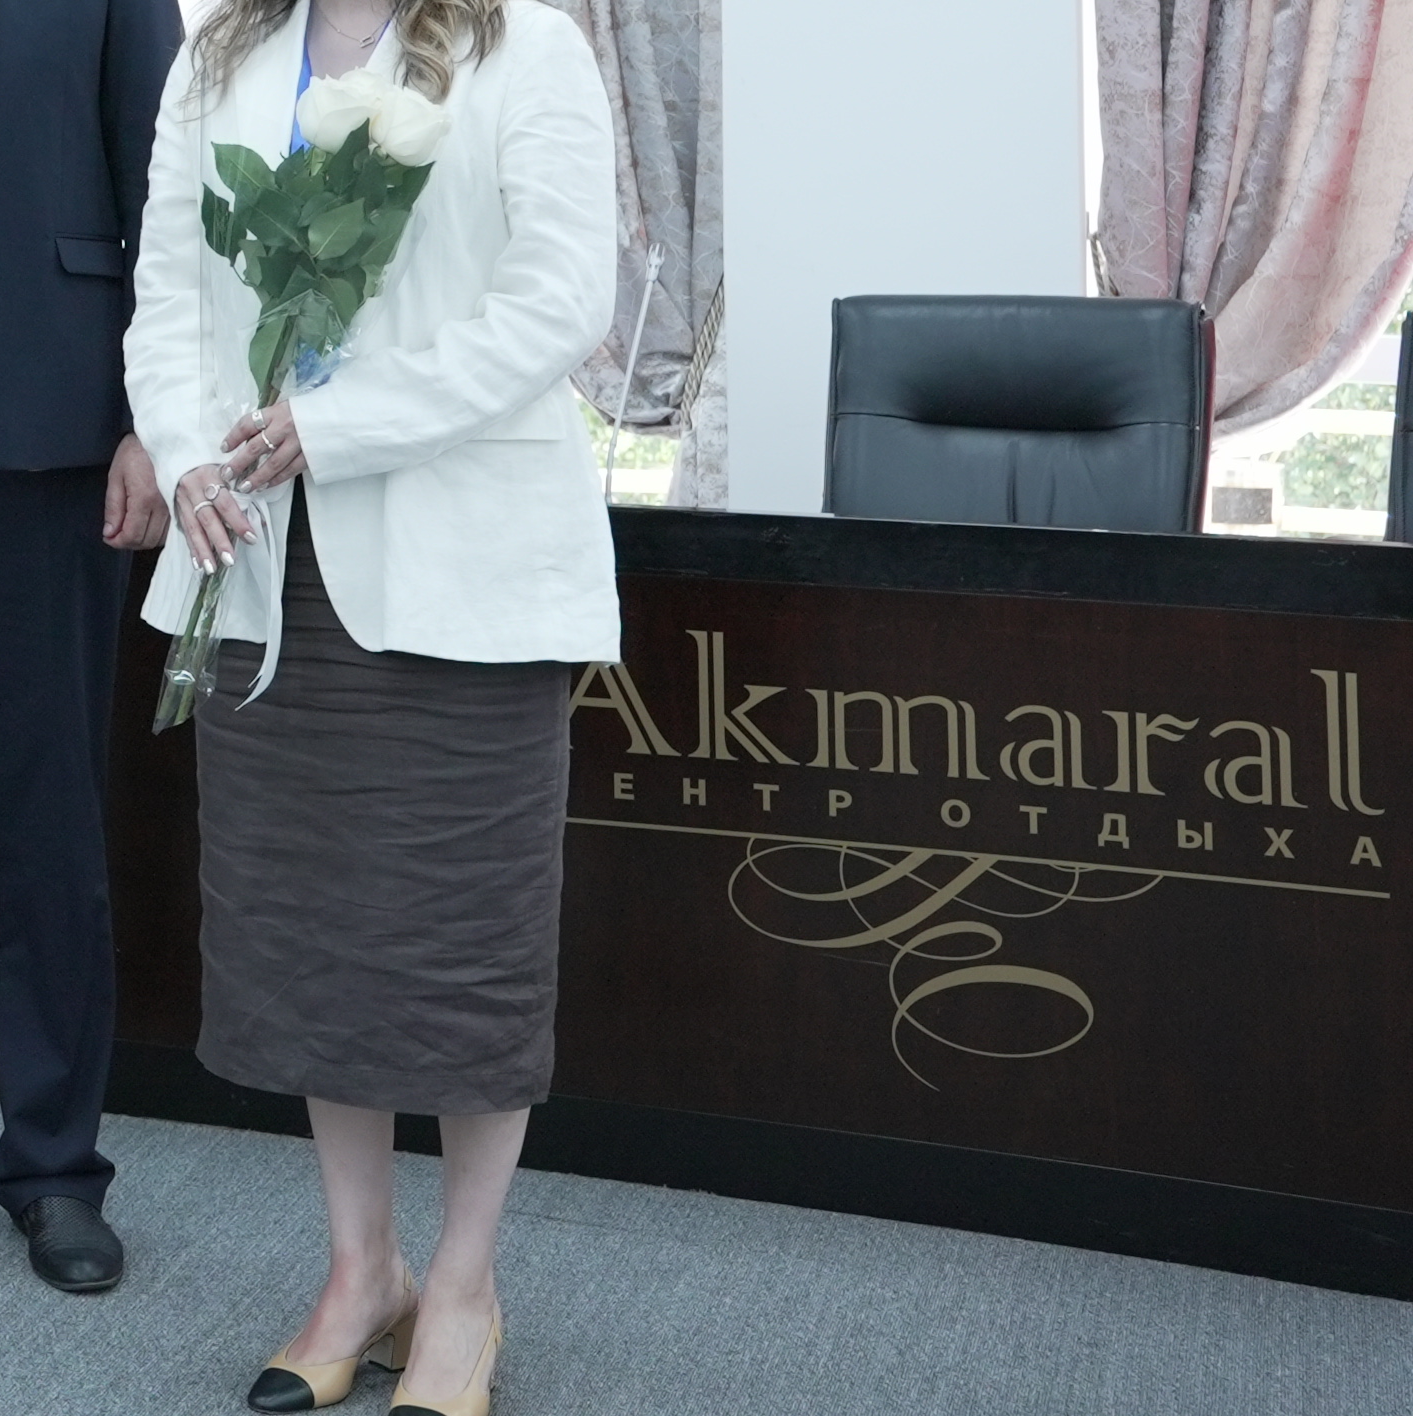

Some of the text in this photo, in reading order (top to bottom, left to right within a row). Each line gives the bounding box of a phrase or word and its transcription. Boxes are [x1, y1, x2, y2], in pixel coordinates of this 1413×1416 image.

[568, 629, 1386, 817] Akmaral
[614, 771, 1383, 869] ЕНТР ОТДЫХА
